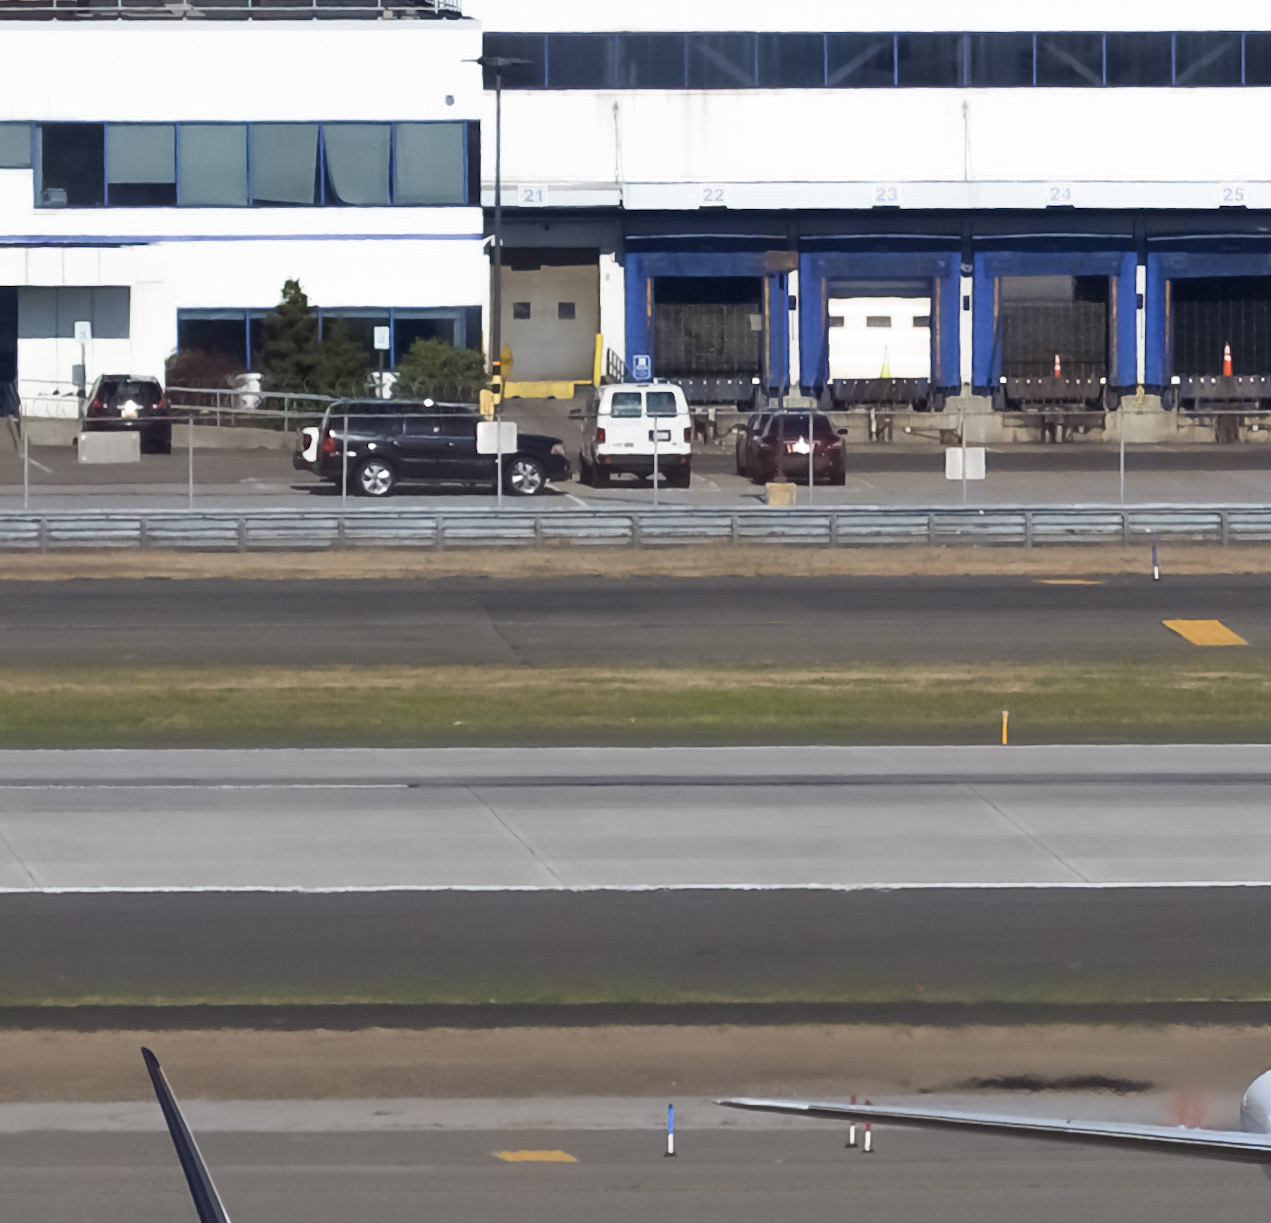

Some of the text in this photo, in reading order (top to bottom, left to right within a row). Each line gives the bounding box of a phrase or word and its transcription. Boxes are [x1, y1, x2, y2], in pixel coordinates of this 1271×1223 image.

[524, 188, 544, 202] 21
[703, 188, 725, 201] 22
[875, 188, 897, 201] 23
[1050, 188, 1072, 201] 24
[1223, 188, 1244, 201] 25
